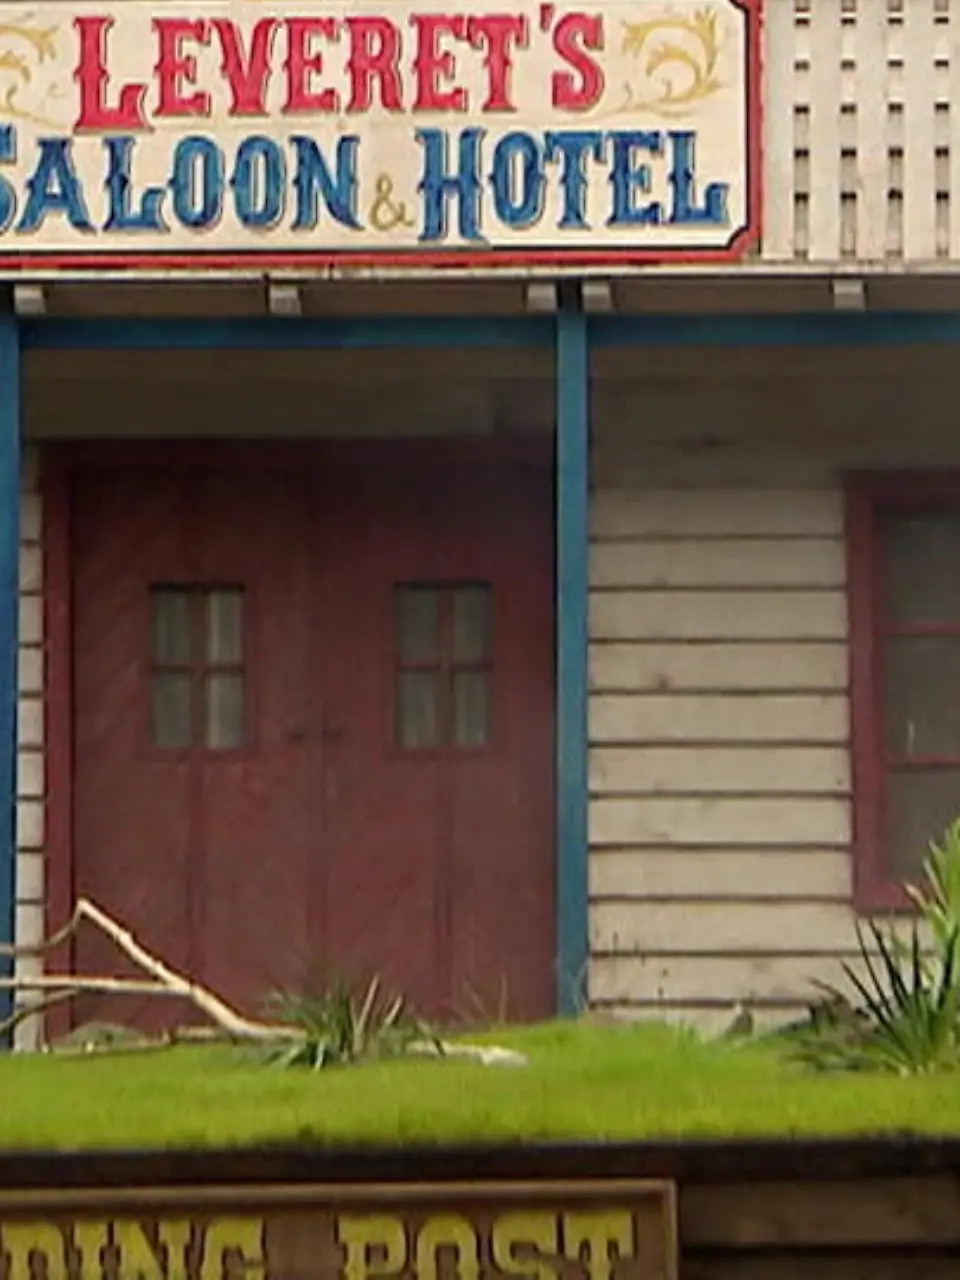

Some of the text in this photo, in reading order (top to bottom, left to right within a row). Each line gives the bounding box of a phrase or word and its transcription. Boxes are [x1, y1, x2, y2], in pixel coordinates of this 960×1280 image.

[73, 3, 605, 132] LEVERET'S
[369, 173, 412, 231] &
[416, 126, 732, 246] HOTEL
[337, 1211, 635, 1280] POST
